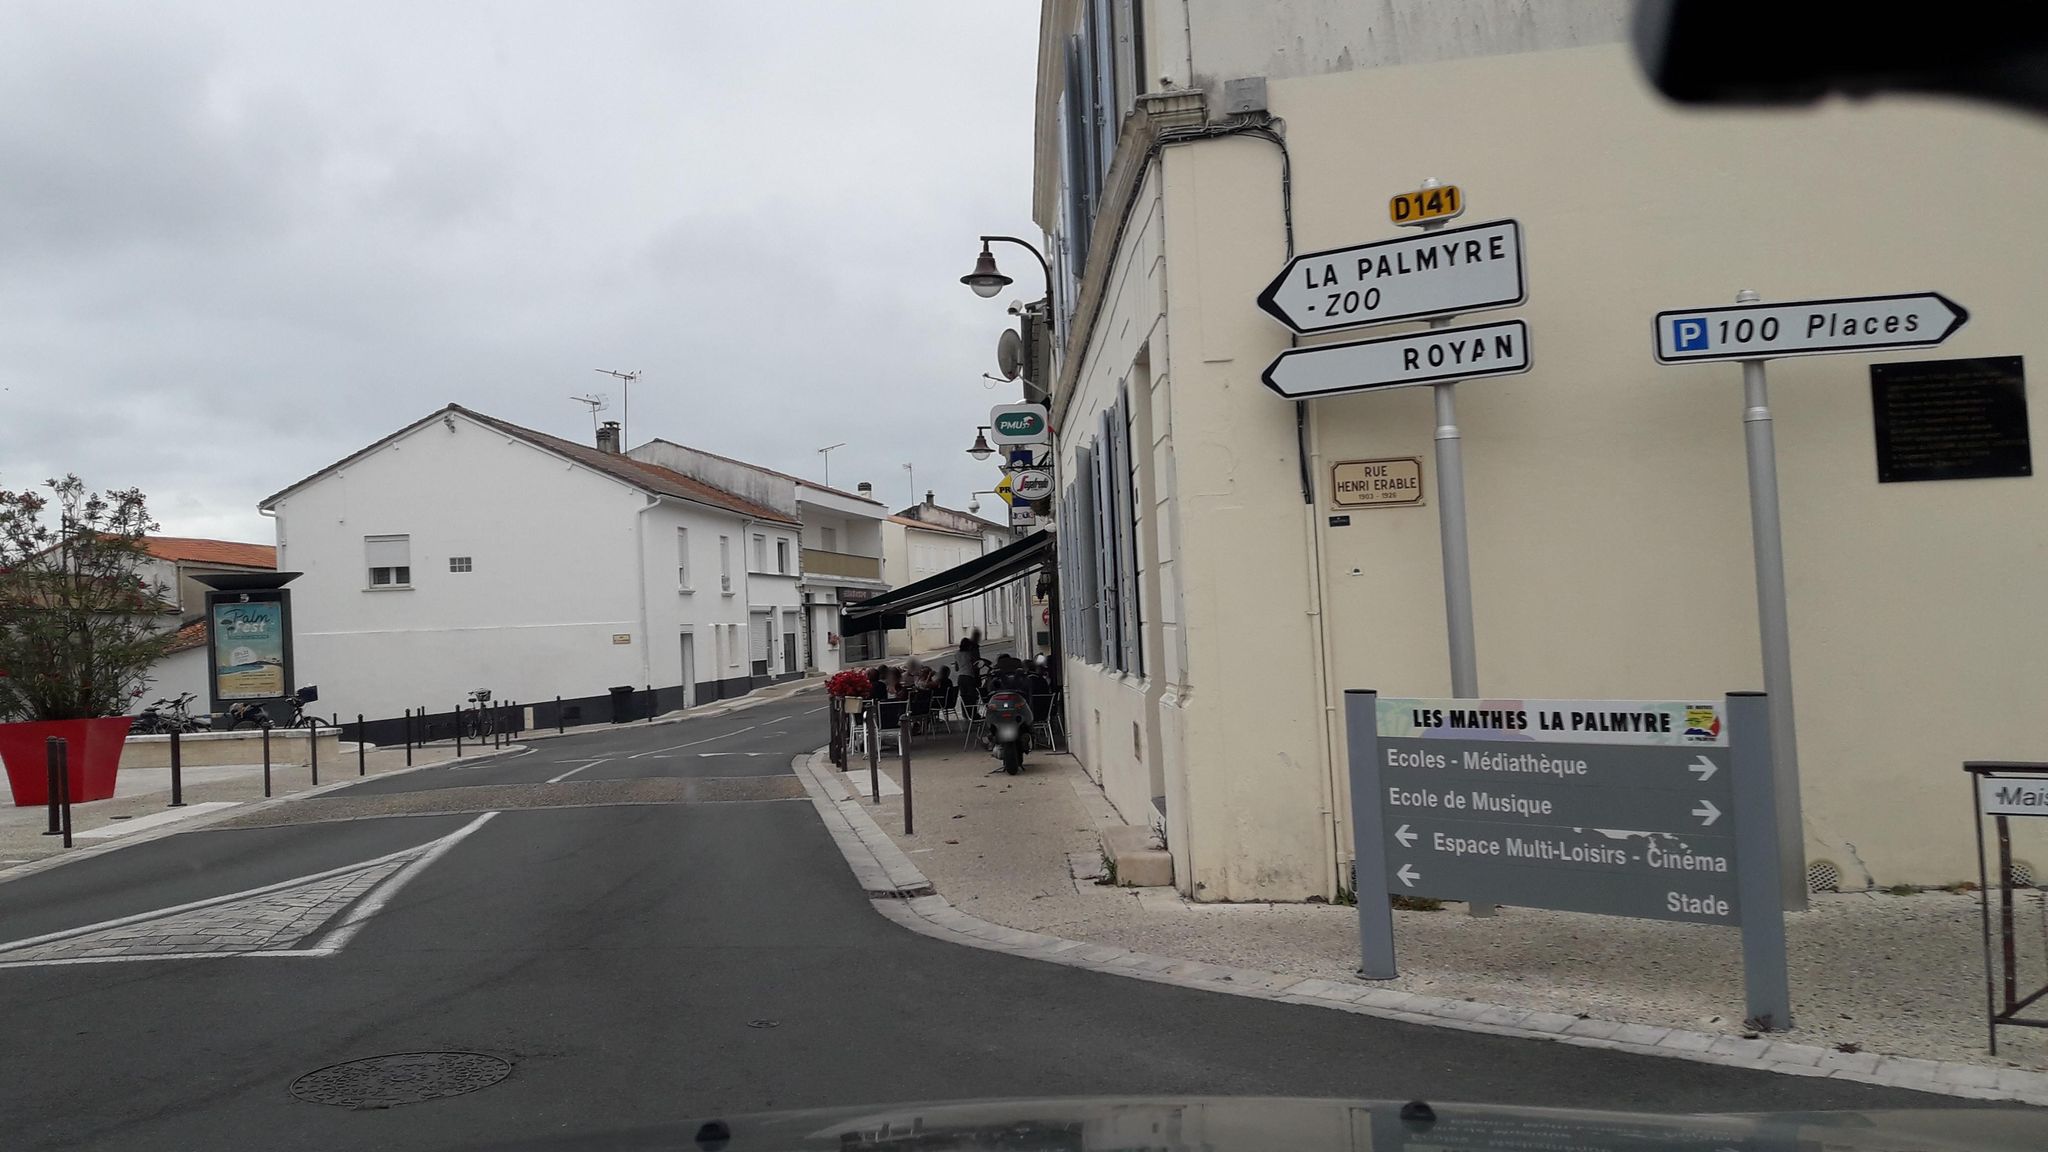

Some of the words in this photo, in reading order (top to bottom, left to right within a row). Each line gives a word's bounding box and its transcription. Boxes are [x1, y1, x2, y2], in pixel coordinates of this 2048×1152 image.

[1395, 188, 1458, 220] D141
[1305, 264, 1338, 290] LA
[1357, 235, 1506, 281] PALMYRE
[1325, 287, 1382, 317] ZOO
[1719, 316, 1780, 345] 100
[1807, 312, 1920, 339] Places
[1403, 333, 1513, 371] ROYAN
[1000, 421, 1022, 430] PMU
[1337, 480, 1369, 493] HENRI
[1374, 477, 1417, 491] ERABLE
[1364, 466, 1388, 478] RUE
[224, 608, 272, 624] Palm
[233, 620, 266, 634] Fest
[1413, 708, 1443, 729] LES
[1449, 709, 1528, 731] MATHES
[1540, 711, 1564, 731] LA
[1571, 711, 1671, 733] PALMYRE
[1387, 748, 1446, 769] Ecoles
[1463, 750, 1588, 777] Médiathèque
[1390, 787, 1438, 808] Ecole
[1444, 789, 1467, 810] de
[1472, 791, 1553, 816] Musique
[1433, 832, 1501, 860] Espace
[1506, 837, 1627, 865] Multi-Loisirs
[1646, 846, 1728, 872] Cinéma
[1667, 892, 1730, 916] Stade
